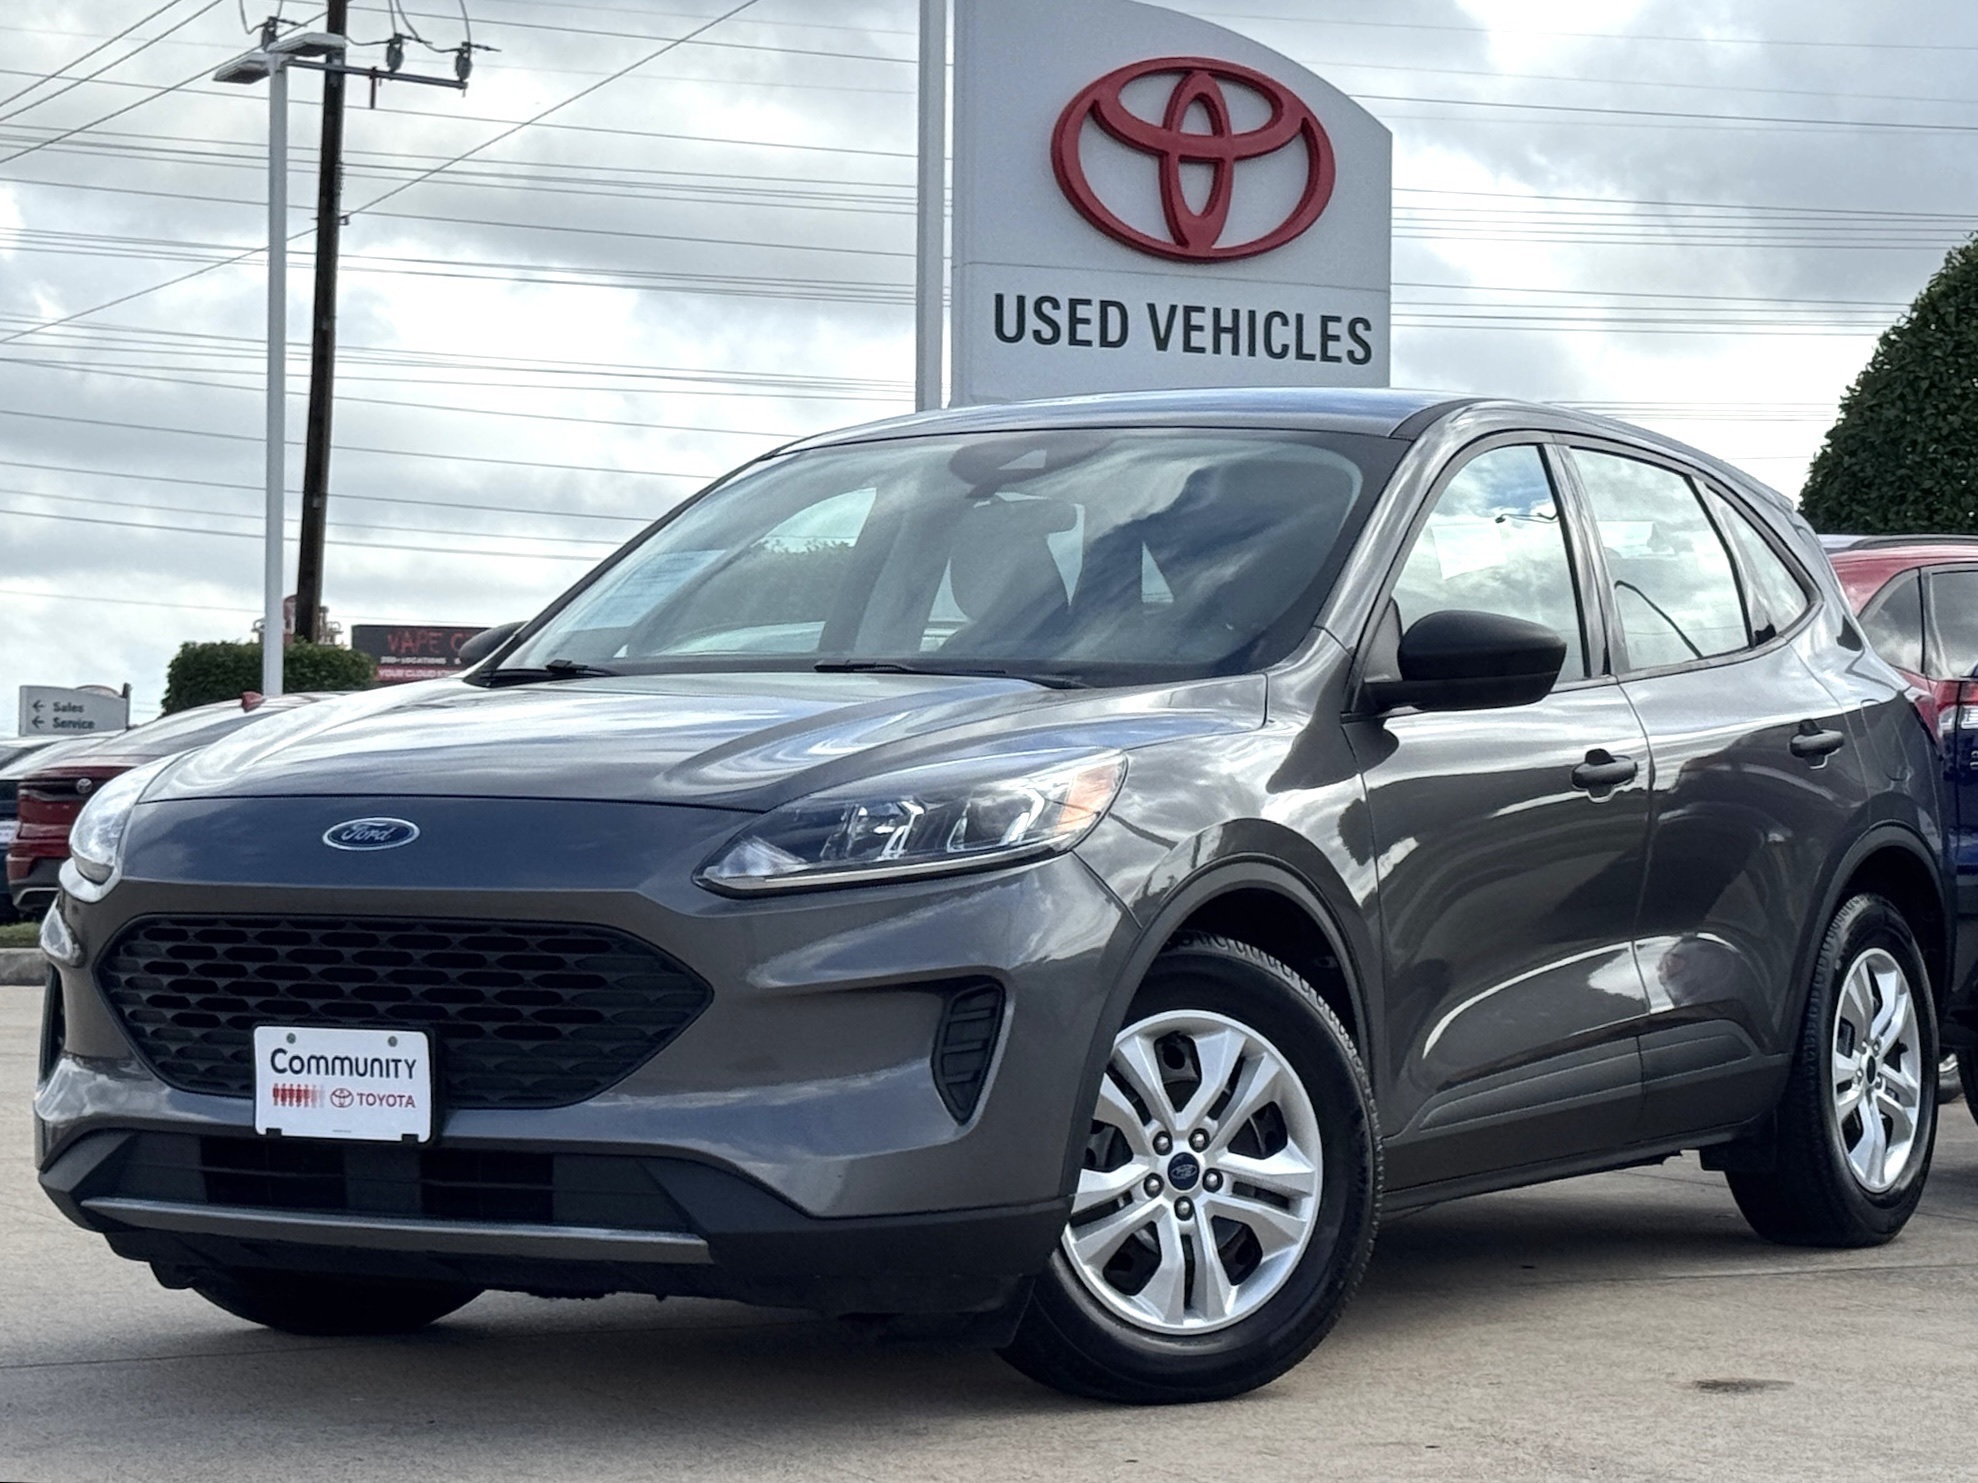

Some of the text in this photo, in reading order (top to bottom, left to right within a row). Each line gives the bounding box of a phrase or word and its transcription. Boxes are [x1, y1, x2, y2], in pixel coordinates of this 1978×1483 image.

[993, 292, 1373, 365] USED VEHICLES
[387, 630, 443, 654] VAPE
[52, 701, 84, 713] Sales
[52, 717, 95, 729] Service
[341, 821, 396, 841] Ford
[357, 1092, 416, 1109] TOYOTA
